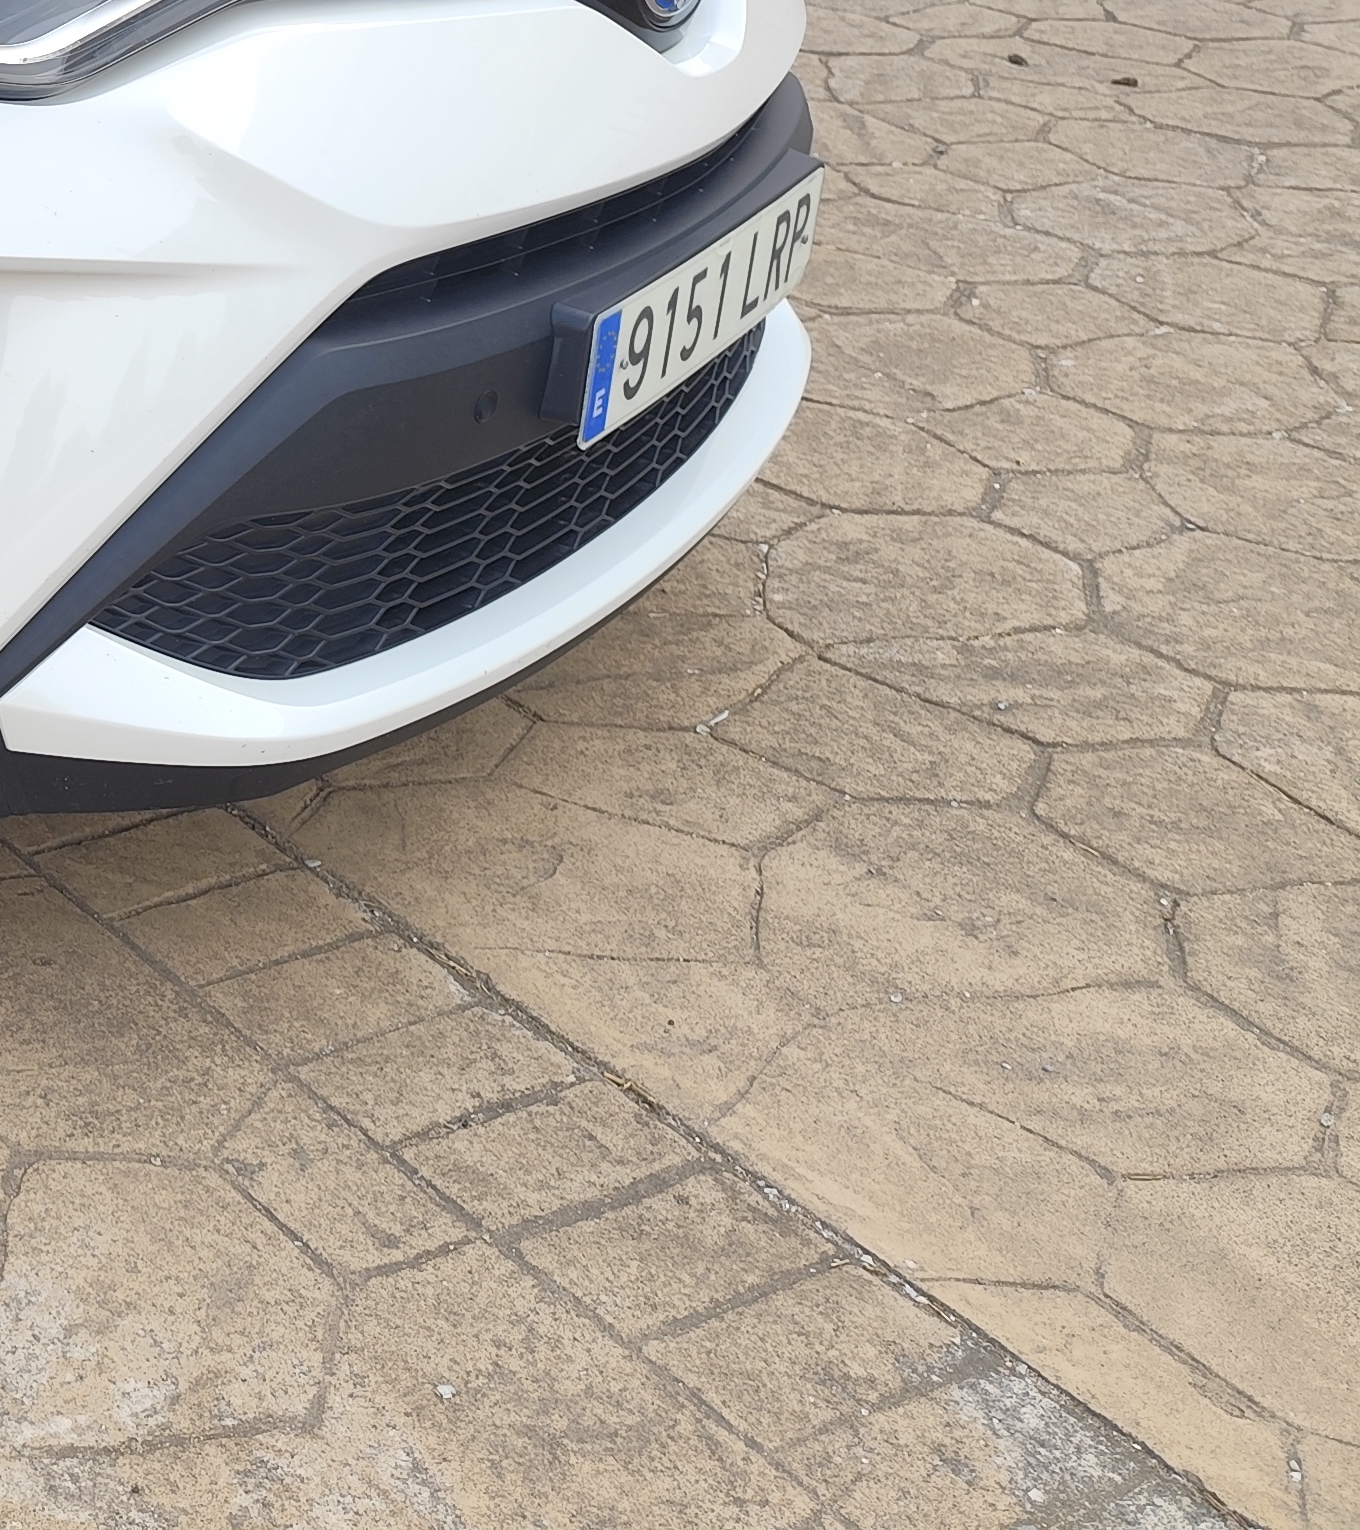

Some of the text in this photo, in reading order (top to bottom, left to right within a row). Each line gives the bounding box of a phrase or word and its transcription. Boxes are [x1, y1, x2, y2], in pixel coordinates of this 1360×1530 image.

[623, 192, 811, 401] 9151 LRP
[592, 387, 606, 419] E
